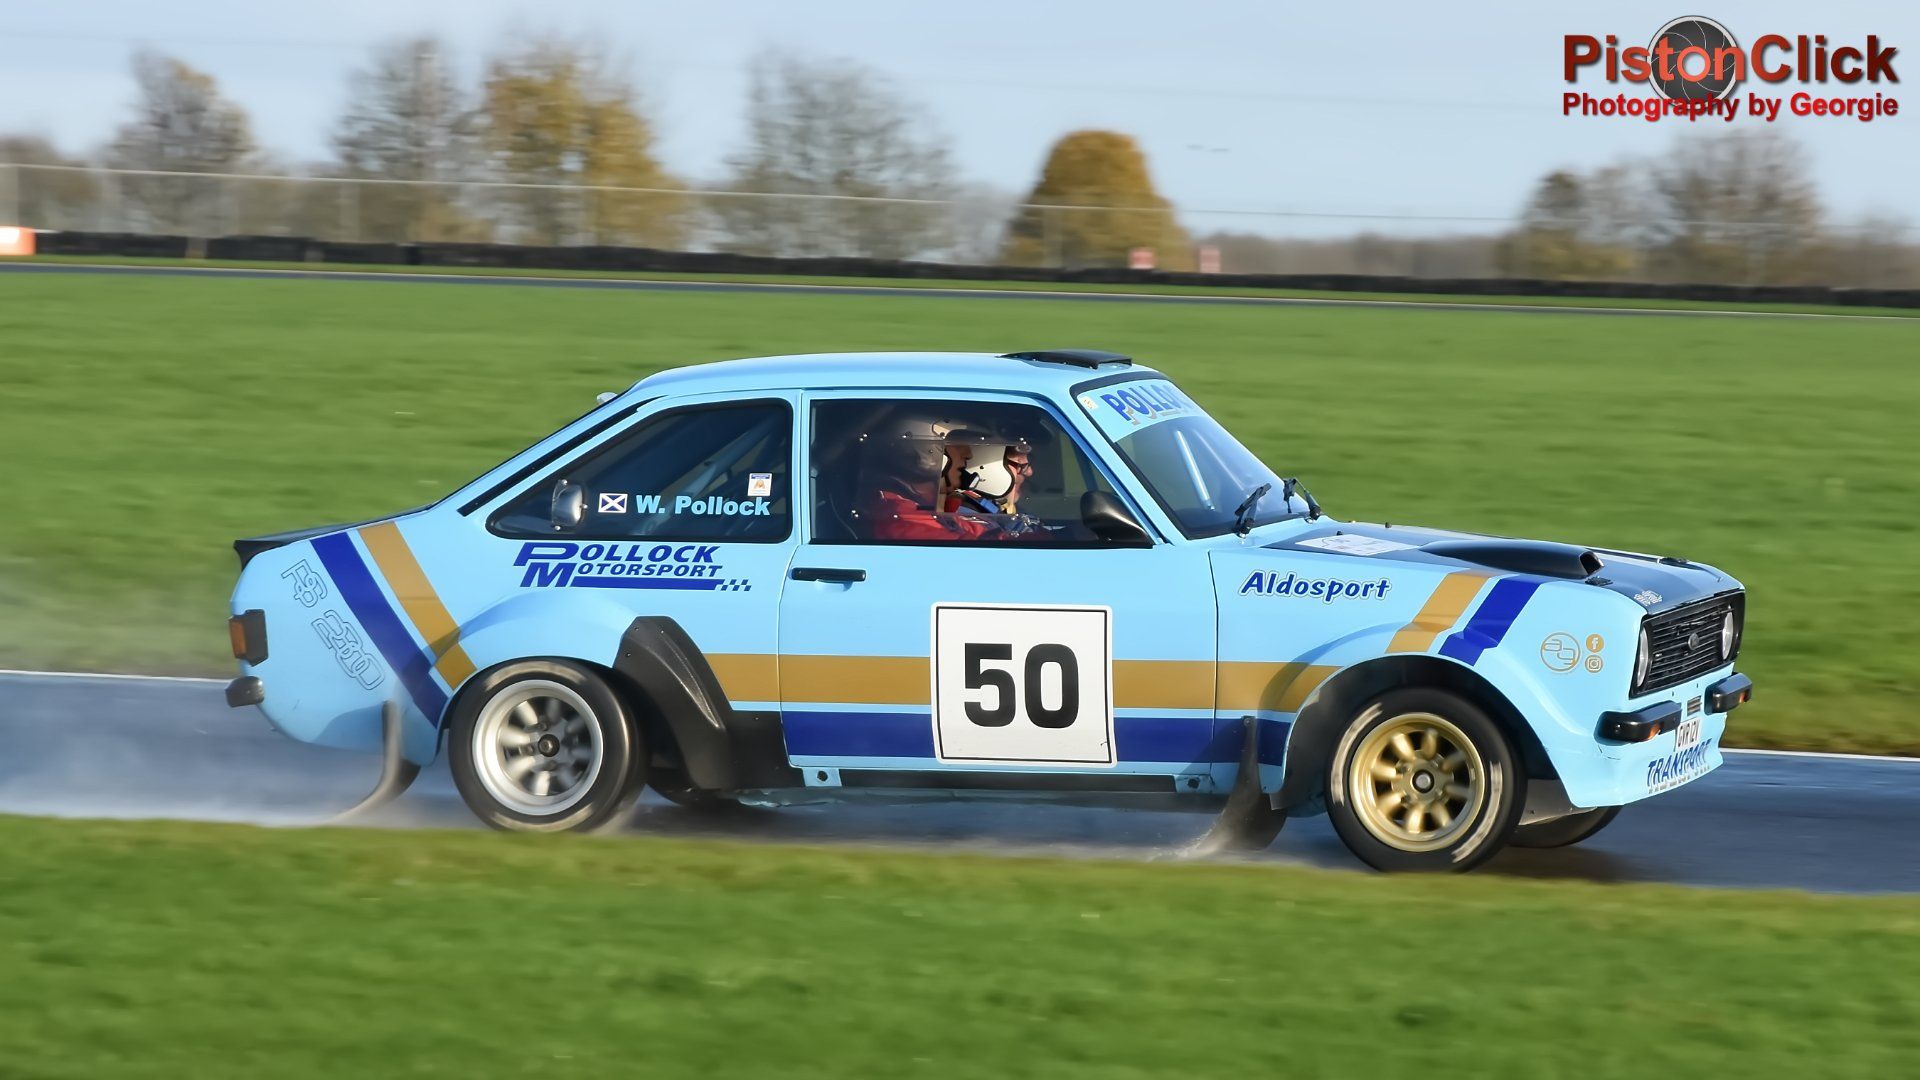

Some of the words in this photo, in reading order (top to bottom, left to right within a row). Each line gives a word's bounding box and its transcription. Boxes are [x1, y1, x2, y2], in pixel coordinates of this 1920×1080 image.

[636, 495, 665, 514] W.
[675, 495, 771, 516] Pollock
[513, 542, 721, 566] POLLOCK
[519, 562, 723, 588] MOTORSPORT
[1240, 570, 1391, 602] Aldosport
[964, 643, 1079, 729] 50
